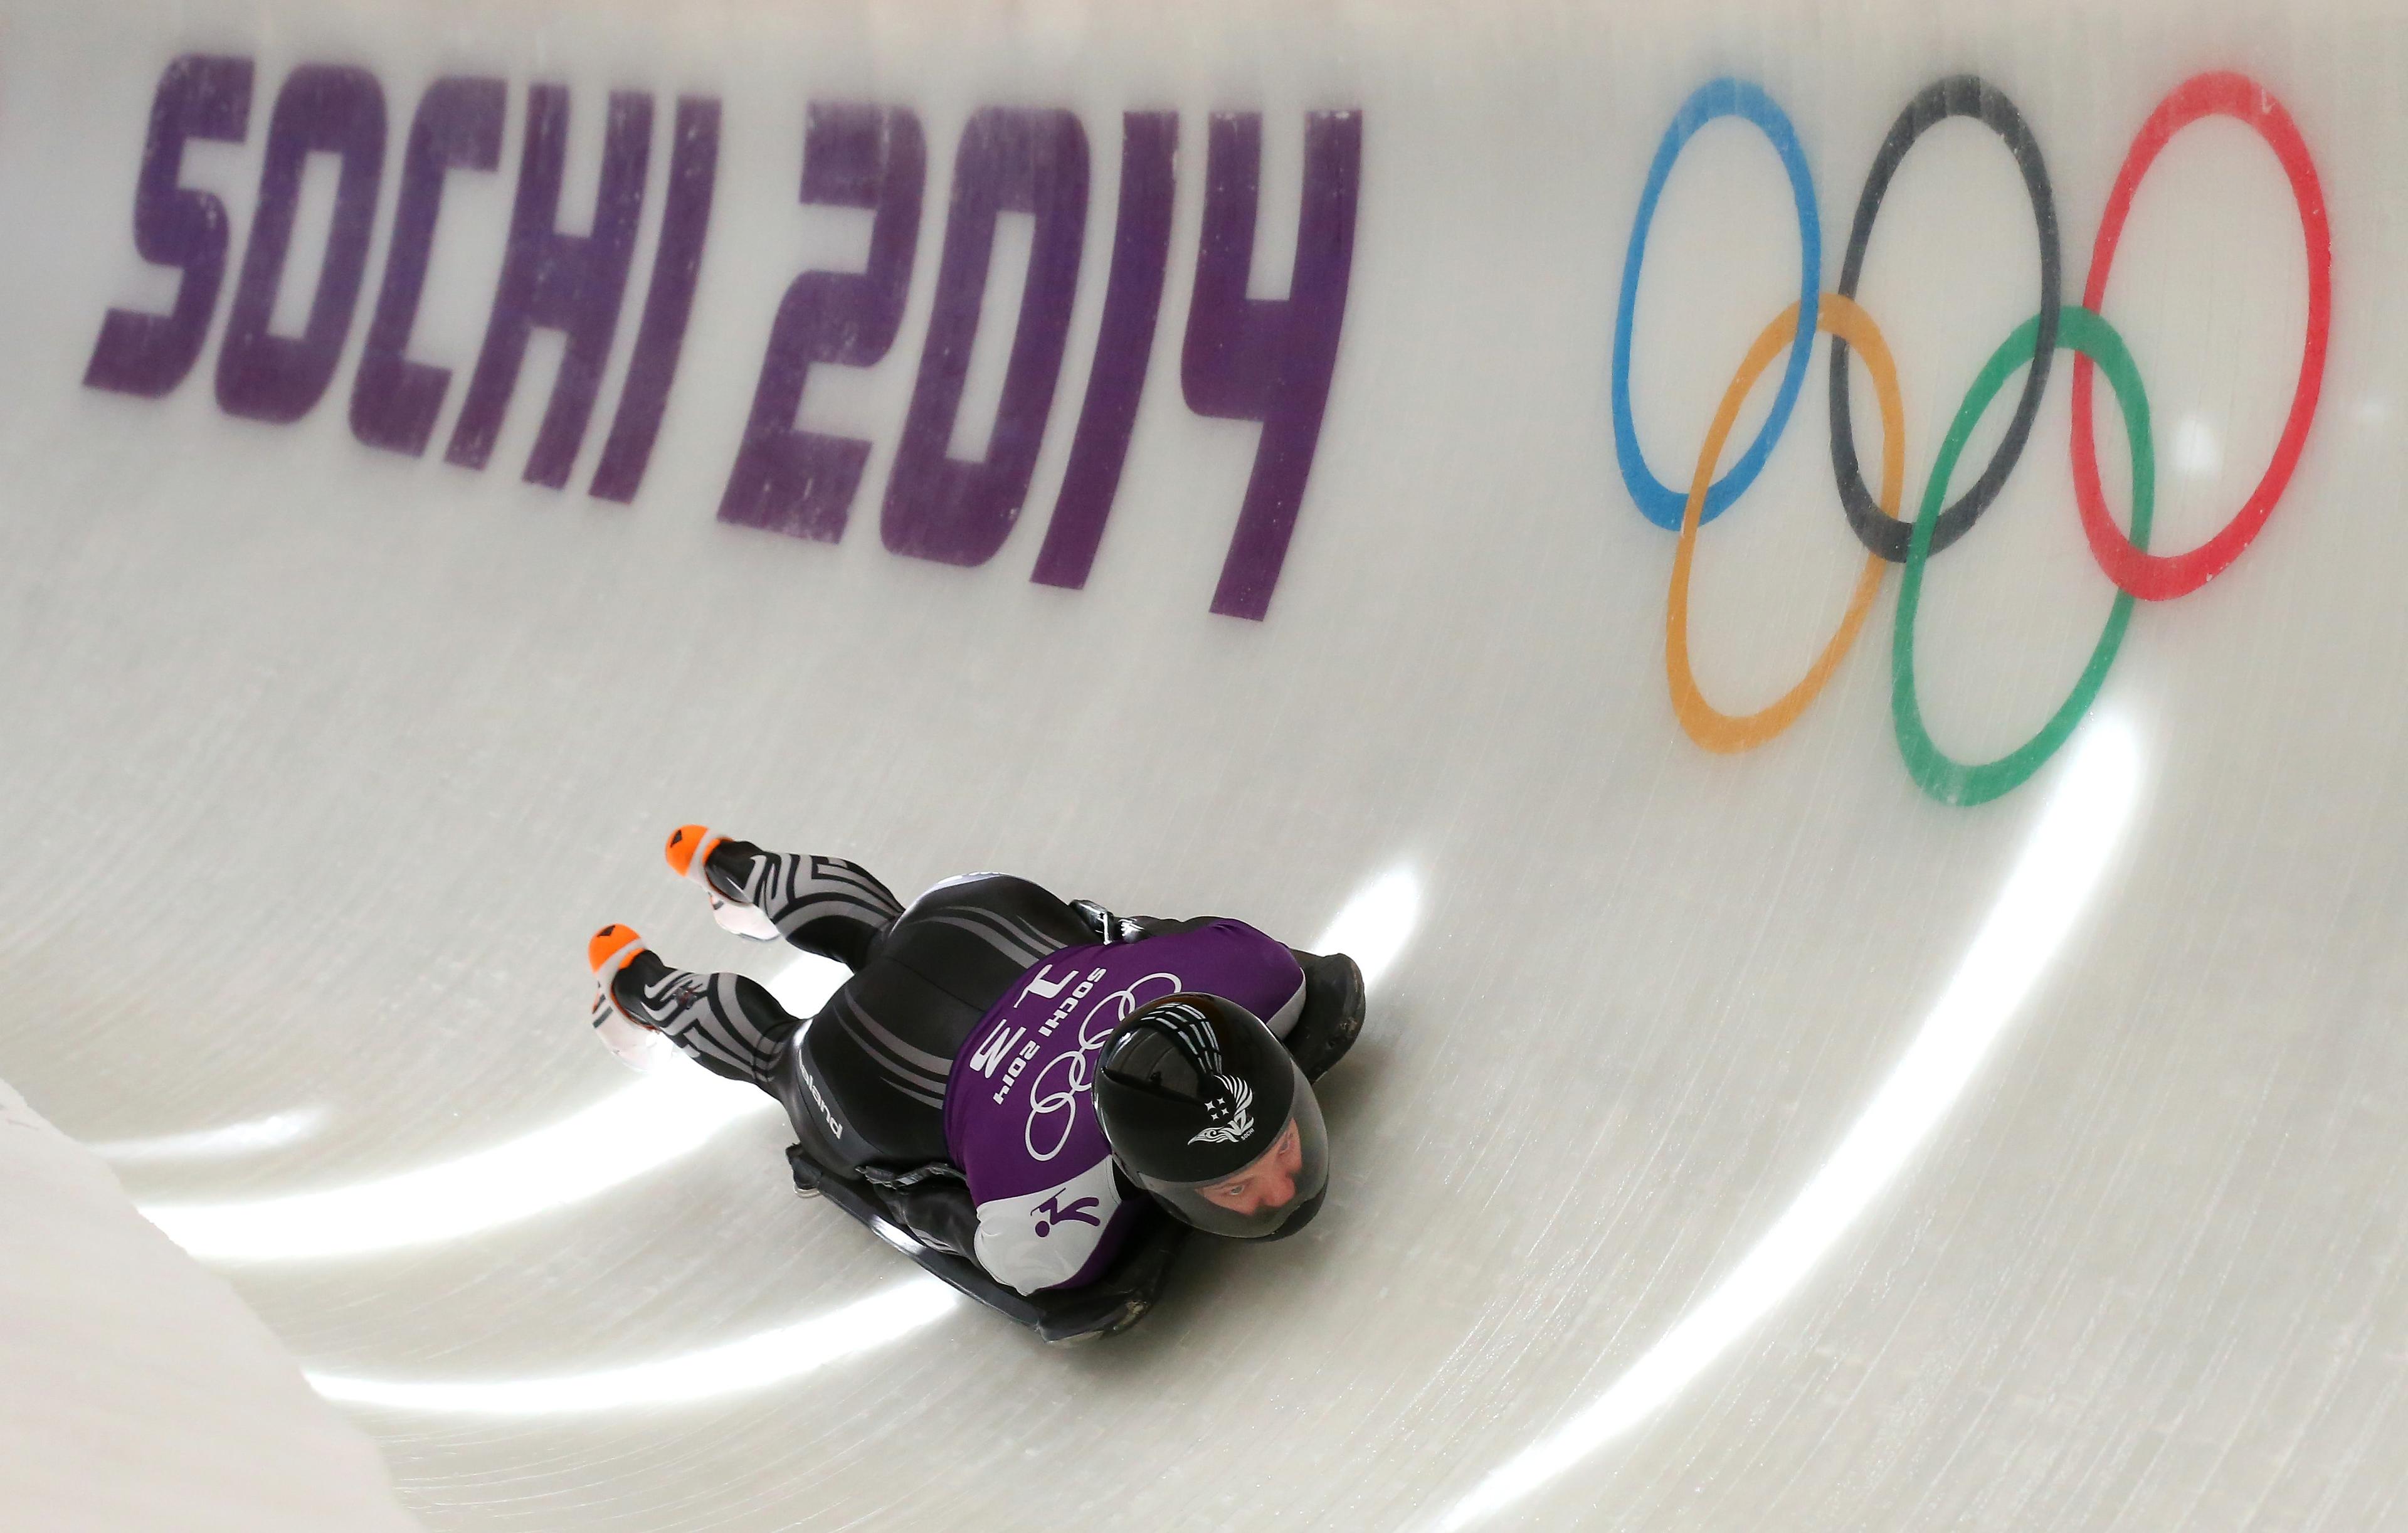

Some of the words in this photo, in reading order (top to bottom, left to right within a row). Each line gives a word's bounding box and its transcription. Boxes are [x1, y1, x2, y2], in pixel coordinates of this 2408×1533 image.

[83, 54, 721, 504] SOCHI
[717, 99, 1363, 622] 2014
[1037, 967, 1107, 1037] SOCHI
[993, 1039, 1042, 1105] 2014
